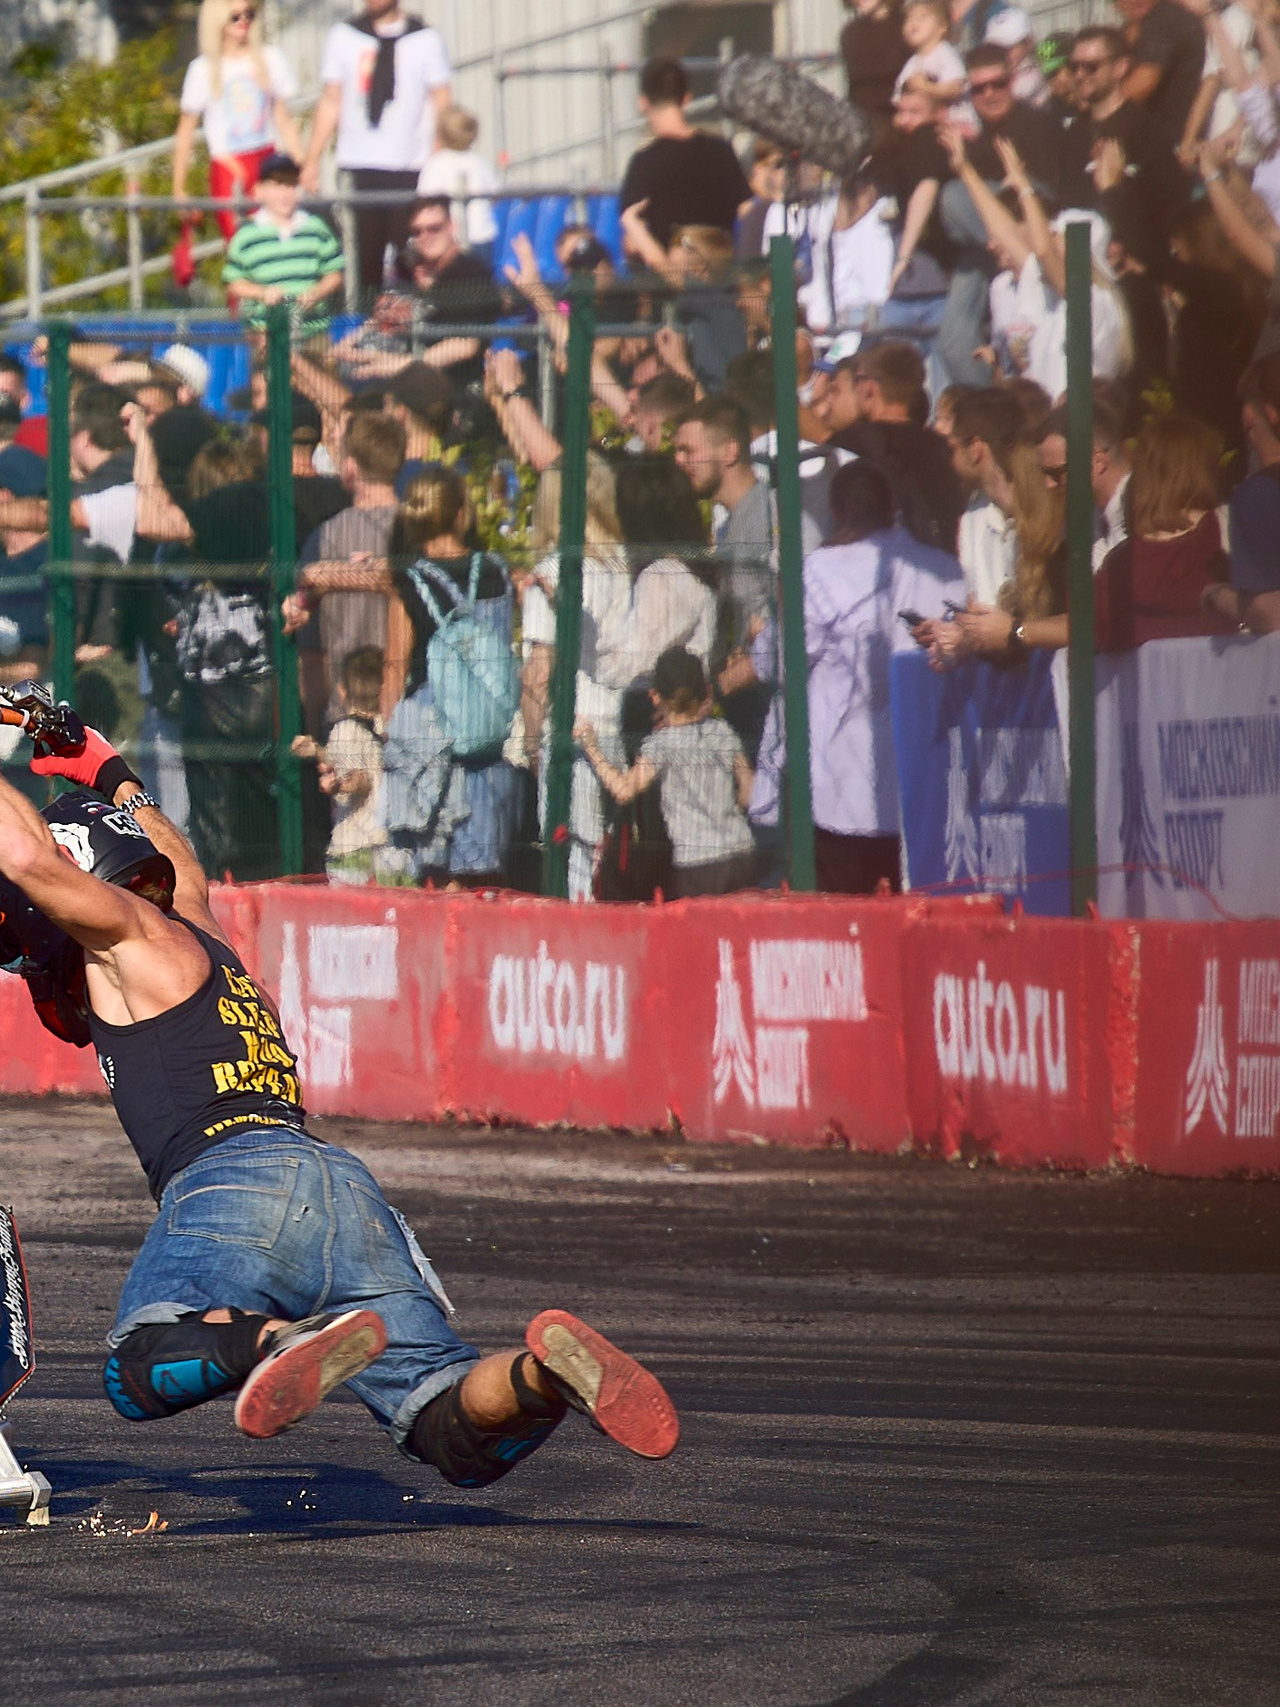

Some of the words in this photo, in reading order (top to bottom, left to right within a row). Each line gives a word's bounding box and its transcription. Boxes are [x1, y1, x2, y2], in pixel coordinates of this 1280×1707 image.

[489, 940, 625, 1059] auto.ru
[933, 960, 1067, 1093] auto.ru
[211, 1061, 302, 1105] REPEA
